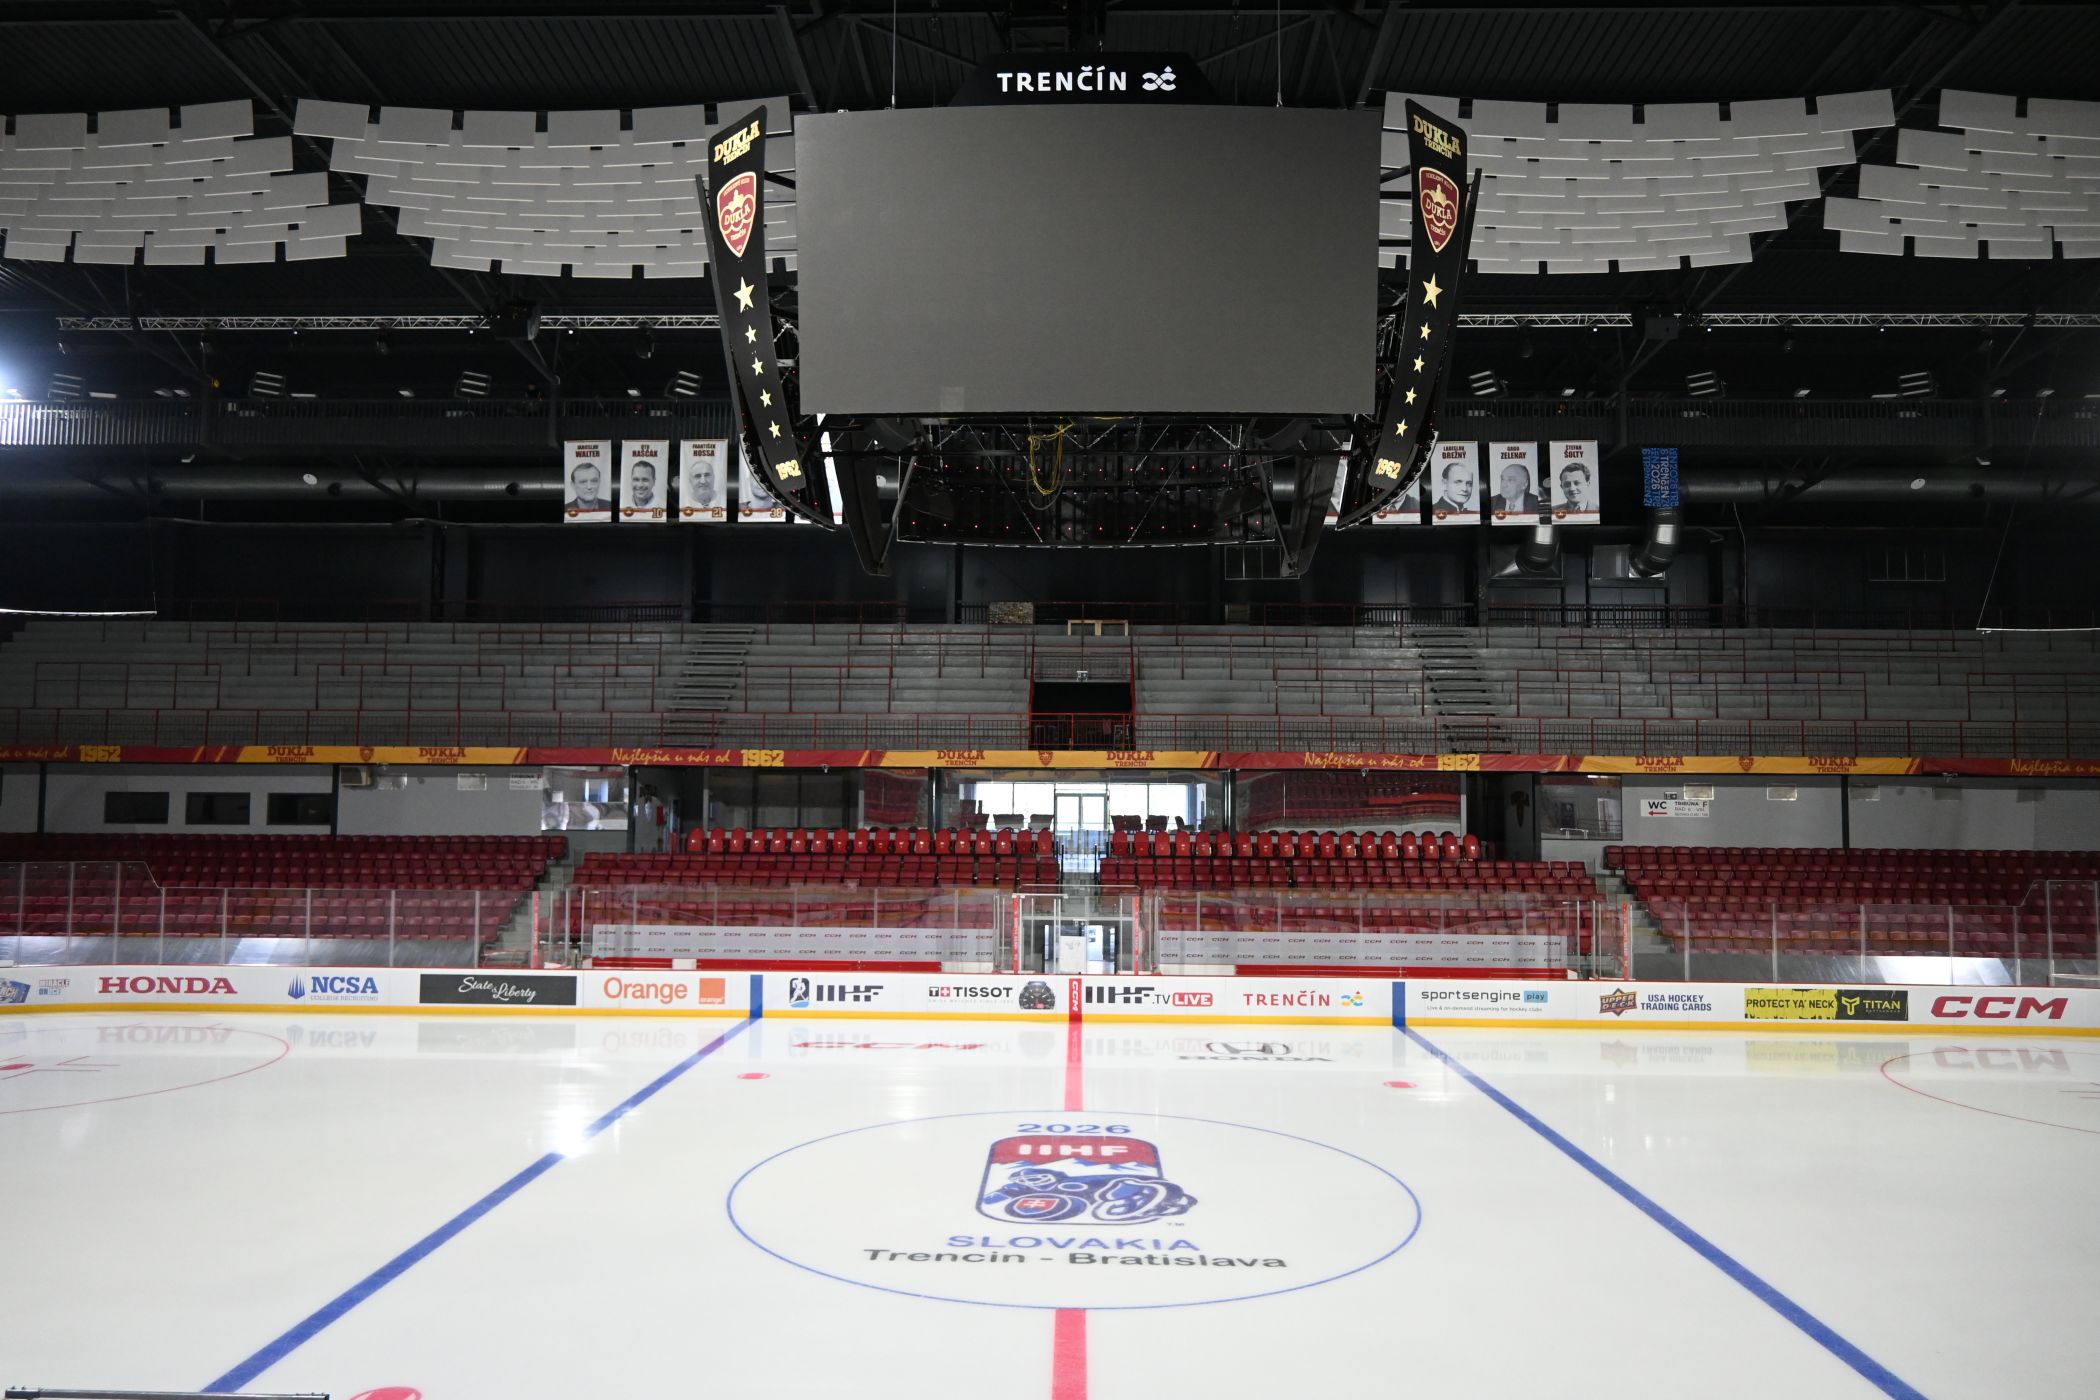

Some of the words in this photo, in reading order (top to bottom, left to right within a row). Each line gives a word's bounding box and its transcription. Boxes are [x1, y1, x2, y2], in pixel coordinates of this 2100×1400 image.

[997, 65, 1127, 92] TRENČÍN
[714, 120, 760, 163] DUKLA
[1413, 114, 1461, 156] DUKLA
[724, 204, 751, 226] DUKLA
[1425, 198, 1452, 220] DUKLA
[575, 450, 600, 458] WALTER
[1501, 451, 1526, 459] ZELENAY
[652, 508, 663, 518] 10
[712, 508, 723, 518] 21
[79, 744, 121, 762] 1962
[267, 746, 314, 757] DUKLA
[419, 747, 466, 758] DUKLA
[612, 748, 670, 765] Najlepšia
[688, 751, 709, 763] nás
[715, 750, 731, 762] od
[741, 749, 784, 767] 1962
[937, 749, 985, 760] DUKLA
[1106, 750, 1155, 761] DUKLA
[1304, 752, 1363, 768] Najlepšia
[1383, 755, 1403, 768] nás
[1410, 754, 1425, 767] od
[1437, 753, 1480, 771] 1962
[1635, 755, 1685, 766] DUKLA
[1808, 756, 1858, 767] DUKLA
[1648, 801, 1667, 810] WC
[98, 976, 238, 994] HONDA
[311, 976, 379, 994] NCSA
[458, 977, 493, 993] State
[496, 983, 537, 1002] Liberty
[603, 977, 688, 1004] Orange
[816, 985, 884, 1002] IIHF
[953, 987, 1013, 998] TISSOT
[1071, 980, 1079, 1012] CCM
[1243, 990, 1331, 1007] TRENČÍN
[1421, 990, 1521, 1003] sportsengine
[1526, 993, 1545, 1002] play
[1602, 994, 1634, 1004] UPPER
[1648, 994, 1665, 1003] USA
[1668, 994, 1704, 1003] HOCKEY
[1175, 993, 1212, 1006] LIVE
[1746, 999, 1790, 1008] PROTECT
[1809, 1000, 1834, 1009] NECK
[1863, 1000, 1901, 1009] TITAN
[1640, 1002, 1679, 1011] TRADING
[1682, 1003, 1712, 1011] CARDS
[1930, 996, 2069, 1020] CCM
[1017, 1123, 1131, 1134] 2026
[1019, 1144, 1129, 1156] IIHF
[946, 1235, 1201, 1251] SLOVAKIA
[863, 1249, 1026, 1263] Trencin
[1068, 1252, 1288, 1268] Bratislava
